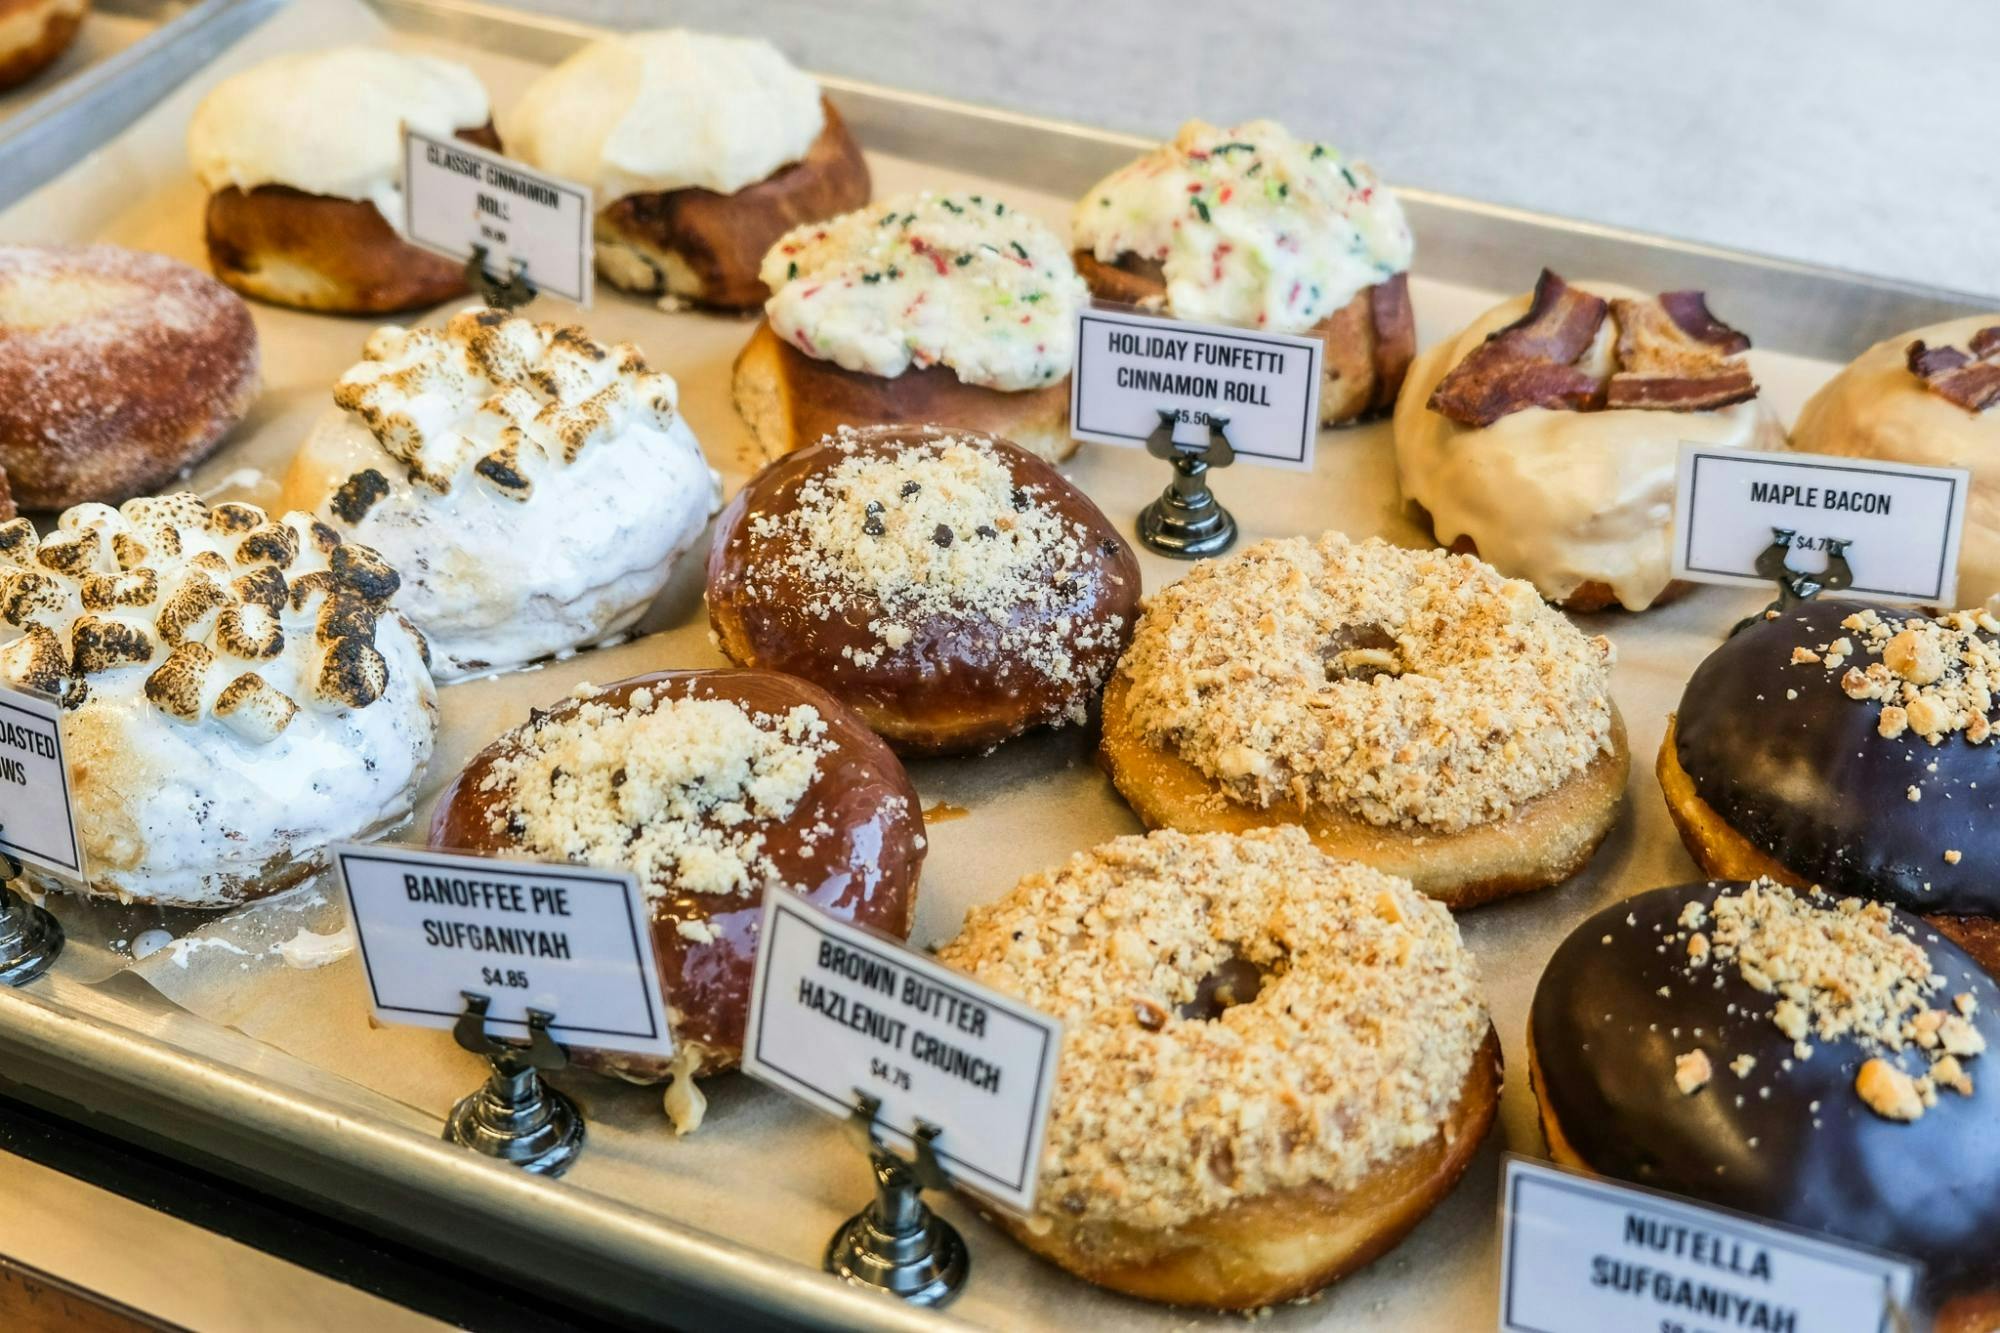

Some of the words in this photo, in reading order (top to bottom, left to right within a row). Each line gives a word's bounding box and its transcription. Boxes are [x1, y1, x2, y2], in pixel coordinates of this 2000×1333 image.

[427, 144, 482, 180] CLASSIC
[486, 167, 560, 210] CINNAMON
[1108, 332, 1188, 362] HOLIDAY
[1193, 342, 1284, 374] FUNFETTI
[1117, 367, 1218, 399] CINNAMON
[1224, 381, 1271, 407] ROLL
[1750, 482, 1818, 507] MAPLE
[1823, 490, 1891, 515] BACON
[0, 756, 26, 786] WS
[403, 874, 527, 914] BANOFFEE
[529, 886, 572, 916] PIE
[422, 919, 572, 959] SUFGANIYAH
[481, 967, 529, 989] $4.85
[818, 940, 897, 998] BROWN
[901, 977, 988, 1039] BUTTER
[798, 978, 907, 1051] HAZLENUT
[912, 1030, 1003, 1094] CRUNCH
[1624, 1213, 1773, 1283] NUTELLA
[1590, 1255, 1797, 1333] SUFGANIYAH
